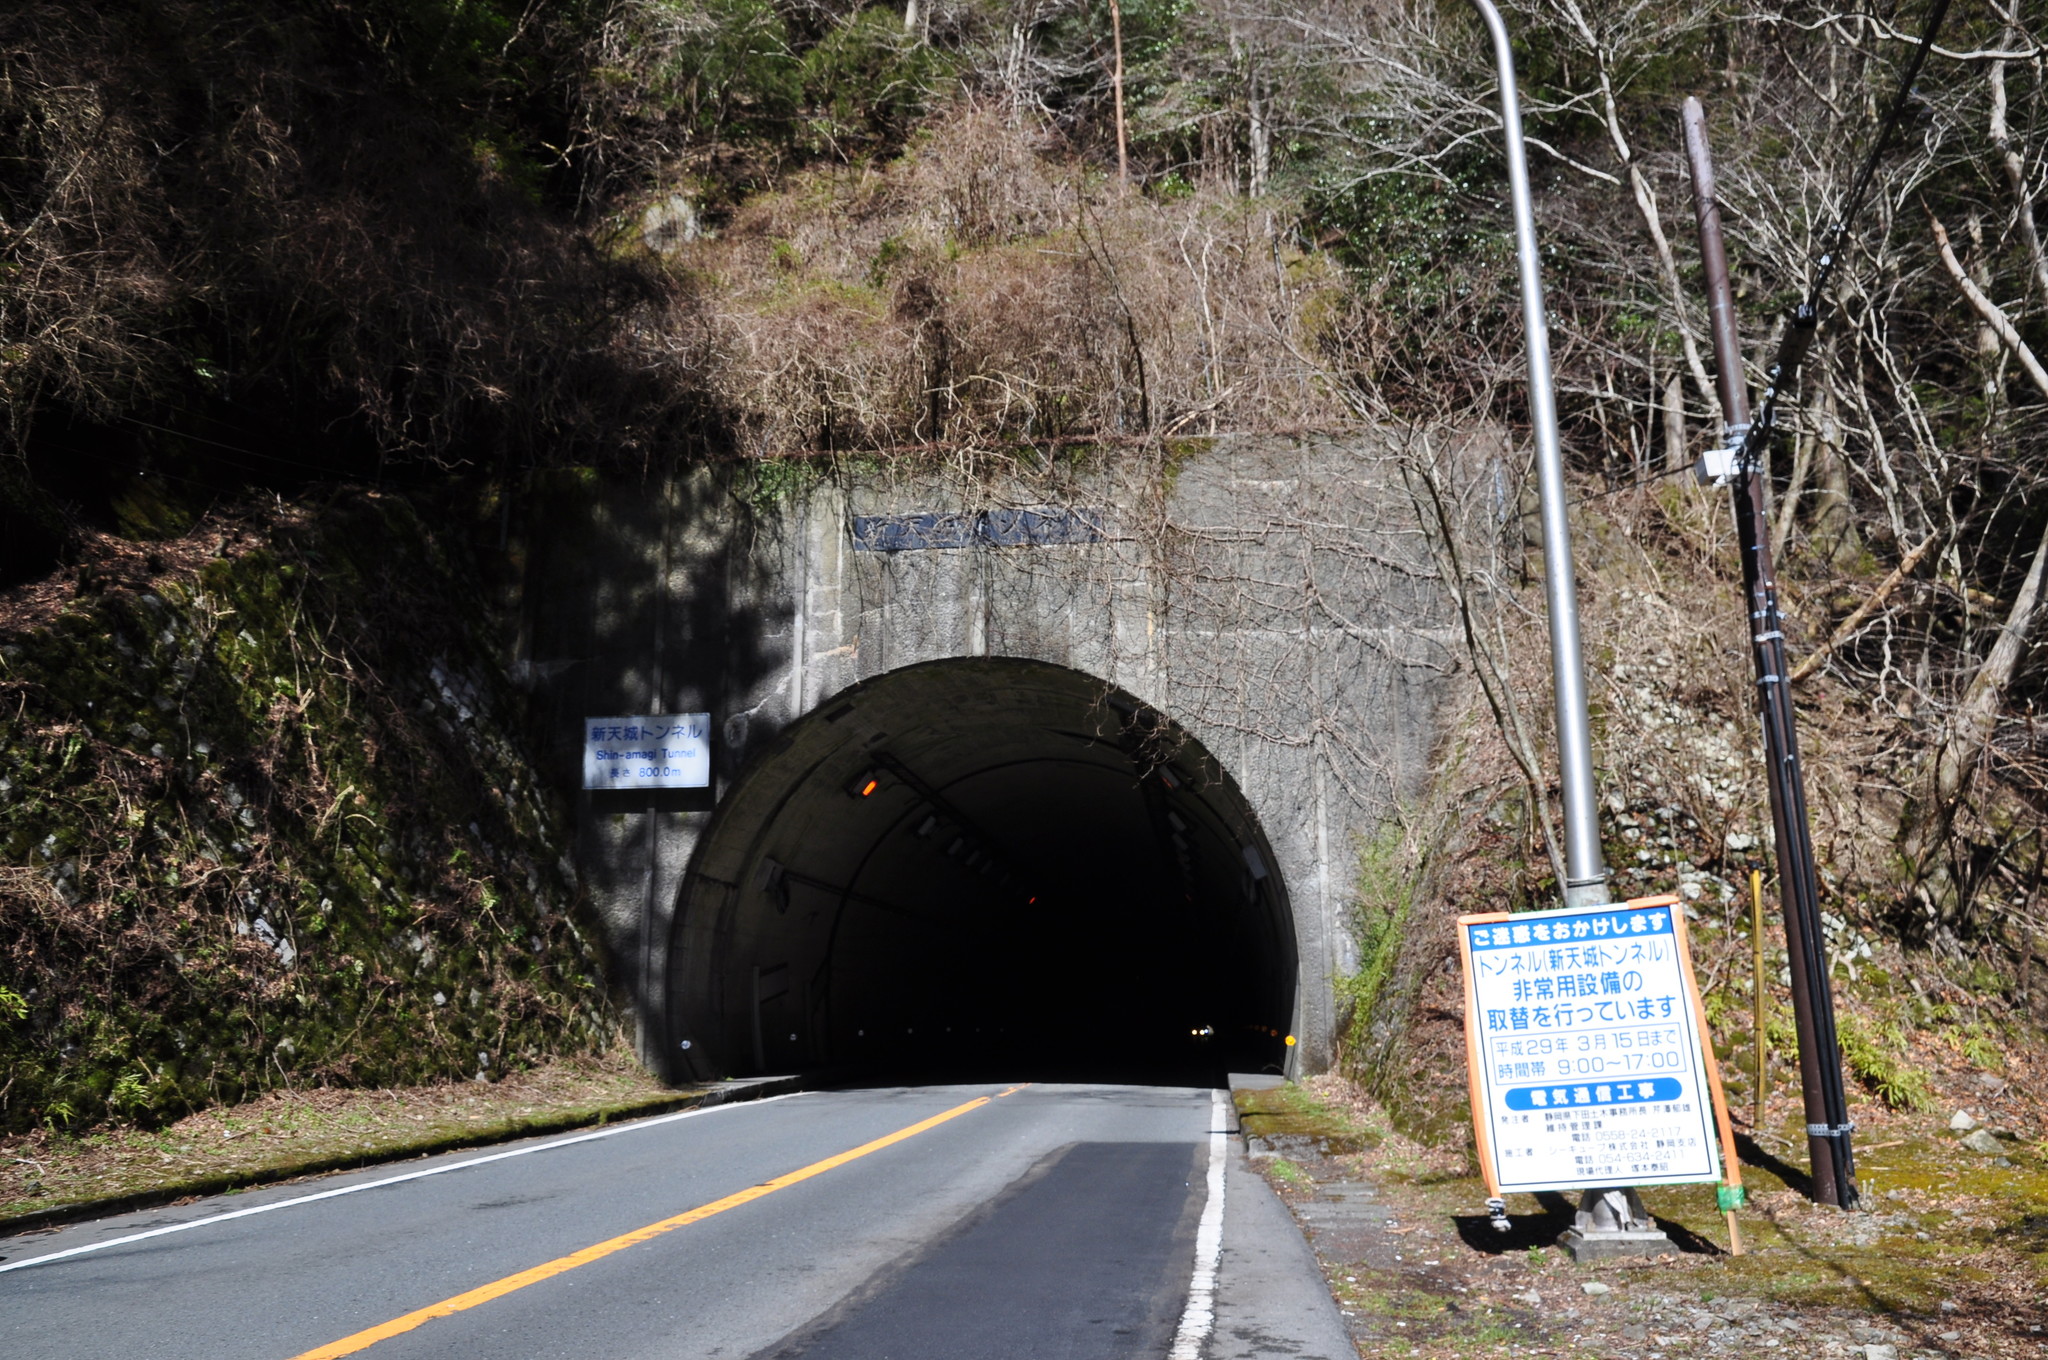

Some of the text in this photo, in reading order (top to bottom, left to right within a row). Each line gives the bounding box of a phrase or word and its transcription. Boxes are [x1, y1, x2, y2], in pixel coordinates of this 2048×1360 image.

[591, 724, 702, 741] 新天城トンネル
[596, 748, 696, 761] Shin-amagi Tunnel
[609, 766, 681, 778] 長さ 800.0m
[1473, 912, 1667, 946] ご迷惑をおかけします
[1480, 939, 1669, 977] トンネル(新天城トンネル)
[1513, 970, 1643, 1002] 非常用設備の
[1487, 994, 1676, 1032] 取替を行っています
[1496, 1037, 1569, 1057] 平成29年
[1498, 1060, 1546, 1080] 時間帯
[1530, 1081, 1656, 1107] 電気通信工事
[1572, 1132, 1591, 1142] 電話
[1575, 1154, 1594, 1165] 電話
